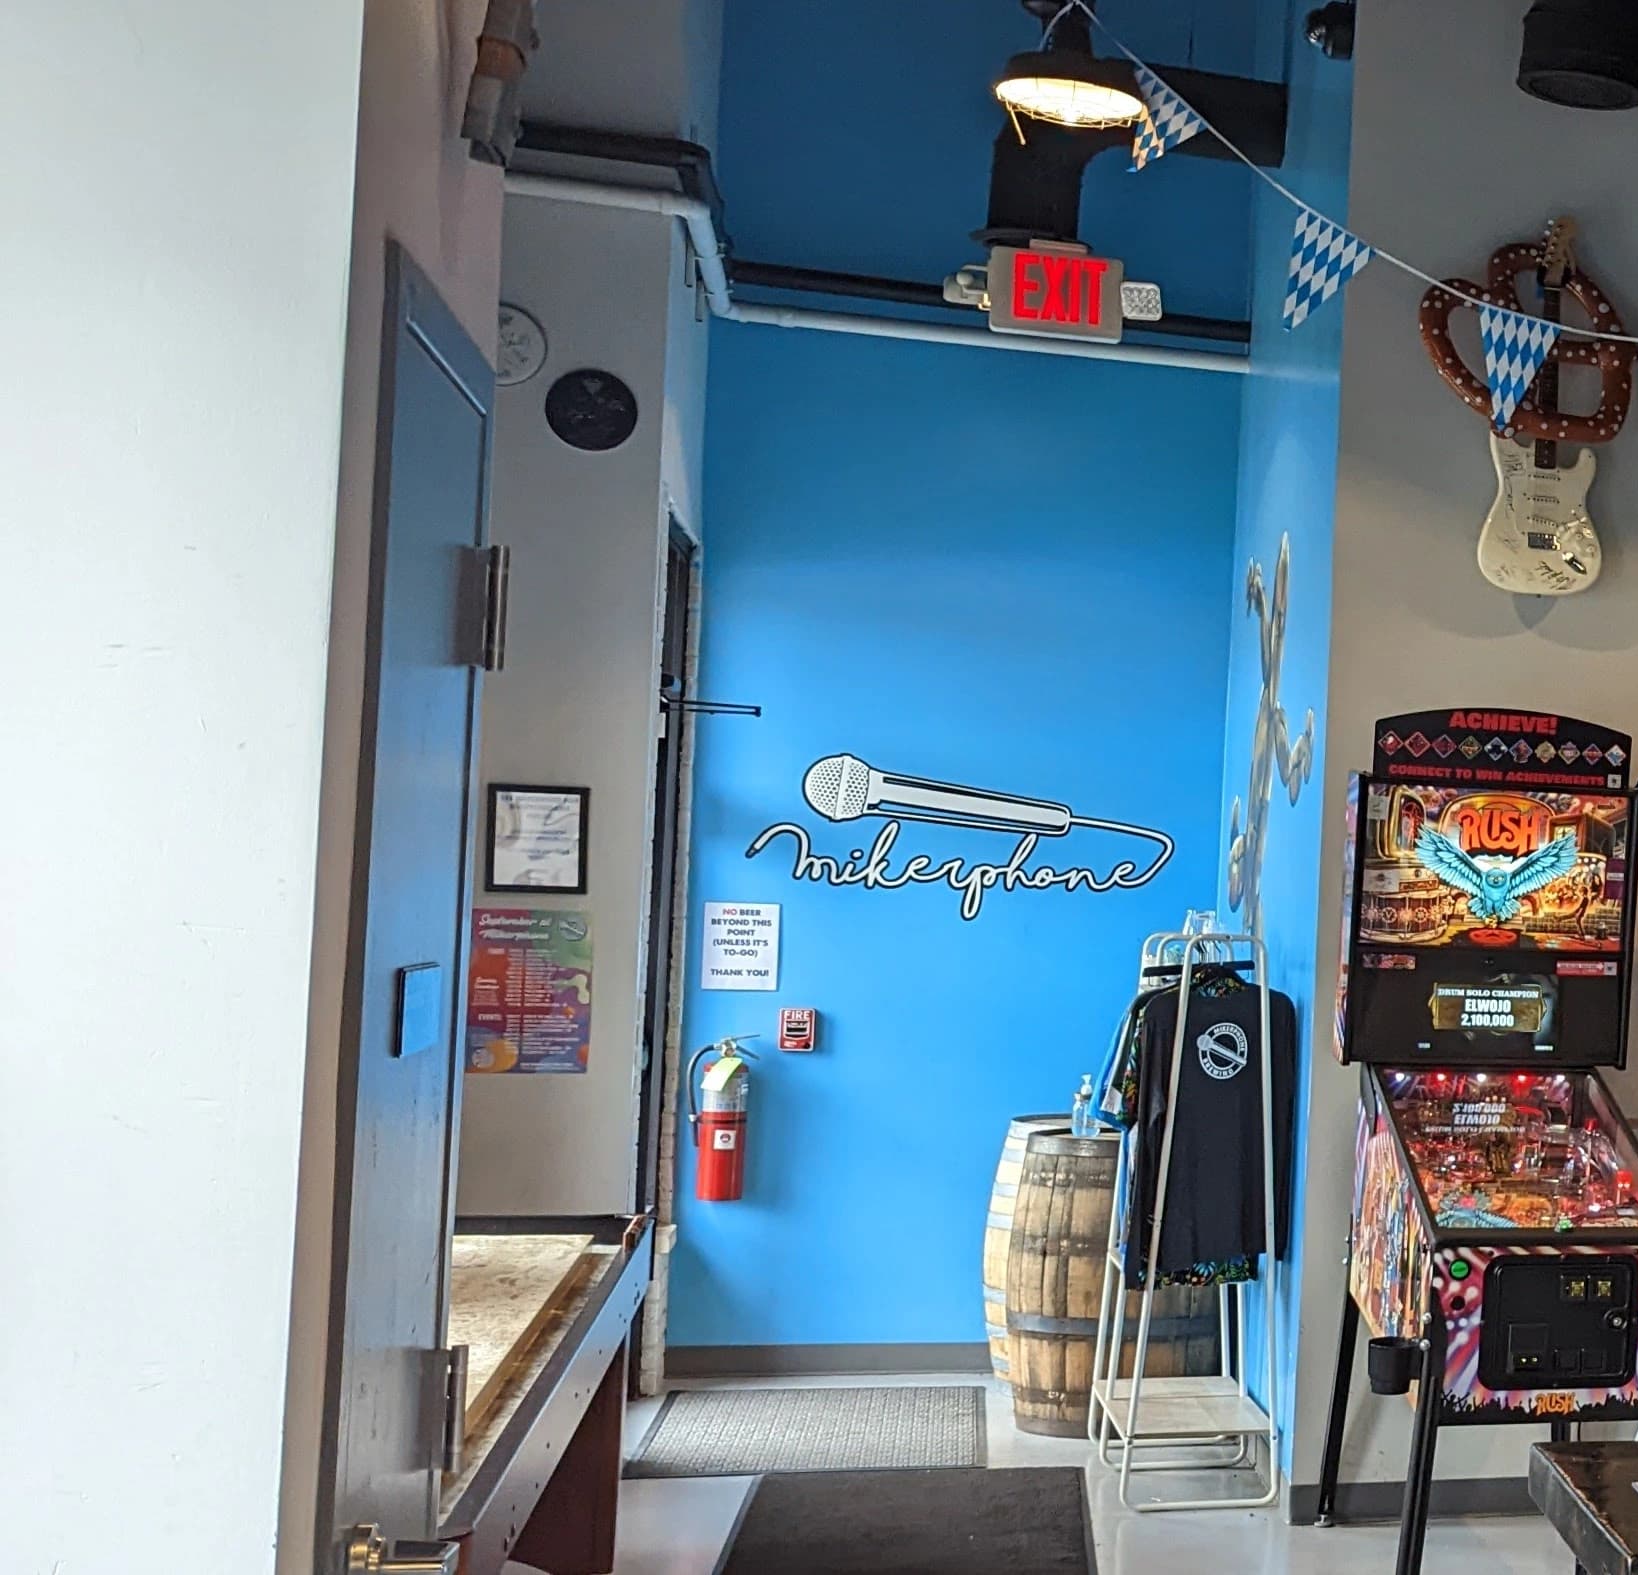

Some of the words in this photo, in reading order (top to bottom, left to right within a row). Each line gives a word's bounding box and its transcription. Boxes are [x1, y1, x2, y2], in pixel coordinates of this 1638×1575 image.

[1013, 252, 1109, 327] EXIT
[1449, 711, 1558, 735] ACHIEVE!
[1388, 764, 1453, 779] CONNECT
[1456, 767, 1472, 780] TO
[1475, 768, 1501, 781] WIN
[1505, 769, 1605, 786] ACHIEVEMENTS
[1458, 806, 1546, 857] RUSH
[723, 908, 737, 916] NO
[711, 918, 749, 926] BEYOND
[752, 919, 772, 927] THIS
[713, 938, 750, 947] (UNLESS
[723, 949, 758, 958] TO-GO)
[711, 968, 743, 976] THANK
[746, 969, 769, 977] YOU!
[1437, 988, 1464, 997] DRUM
[1466, 988, 1489, 998] SOLO
[1491, 989, 1540, 999] CHAMPION
[1464, 999, 1511, 1013] ELWOJO
[784, 1010, 810, 1020] FIRE
[1535, 1392, 1576, 1416] RUSH
